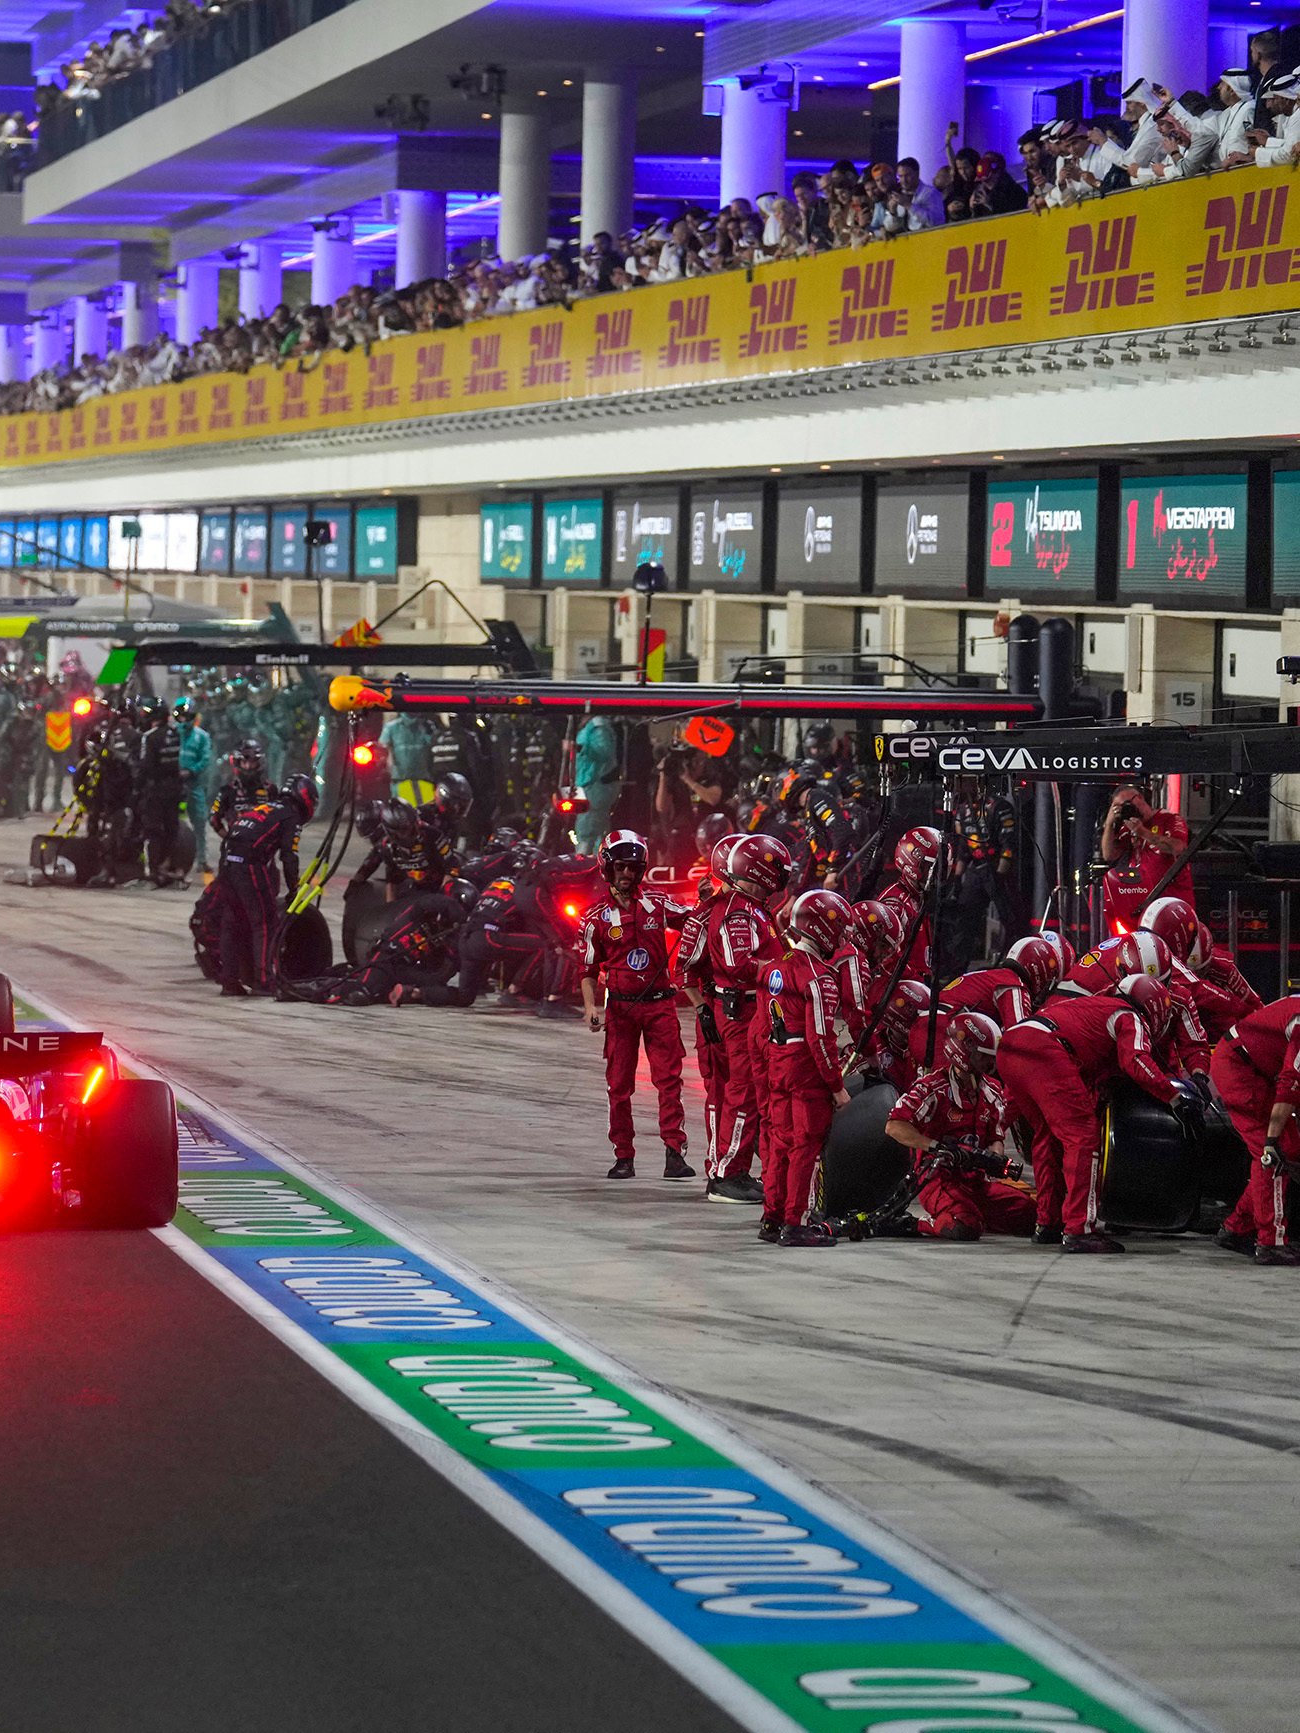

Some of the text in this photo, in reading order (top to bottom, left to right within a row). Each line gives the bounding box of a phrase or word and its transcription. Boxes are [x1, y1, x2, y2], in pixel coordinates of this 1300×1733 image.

[1055, 214, 1150, 316] DHL
[1194, 185, 1300, 296] DHL
[742, 278, 805, 358] DHL
[832, 259, 905, 345] DHL
[936, 240, 1018, 332] DHL
[661, 295, 717, 368] DHL
[1037, 510, 1082, 531] TSUNODA
[1166, 507, 1236, 530] VERSTAPPEN
[1172, 692, 1195, 707] 15
[1042, 756, 1143, 769] LOGISTICS
[1118, 886, 1148, 895] brembo
[629, 949, 648, 969] hp
[770, 970, 783, 994] hp
[257, 1254, 492, 1332] aramco
[387, 1354, 674, 1452] aramco
[563, 1484, 920, 1619] aramco
